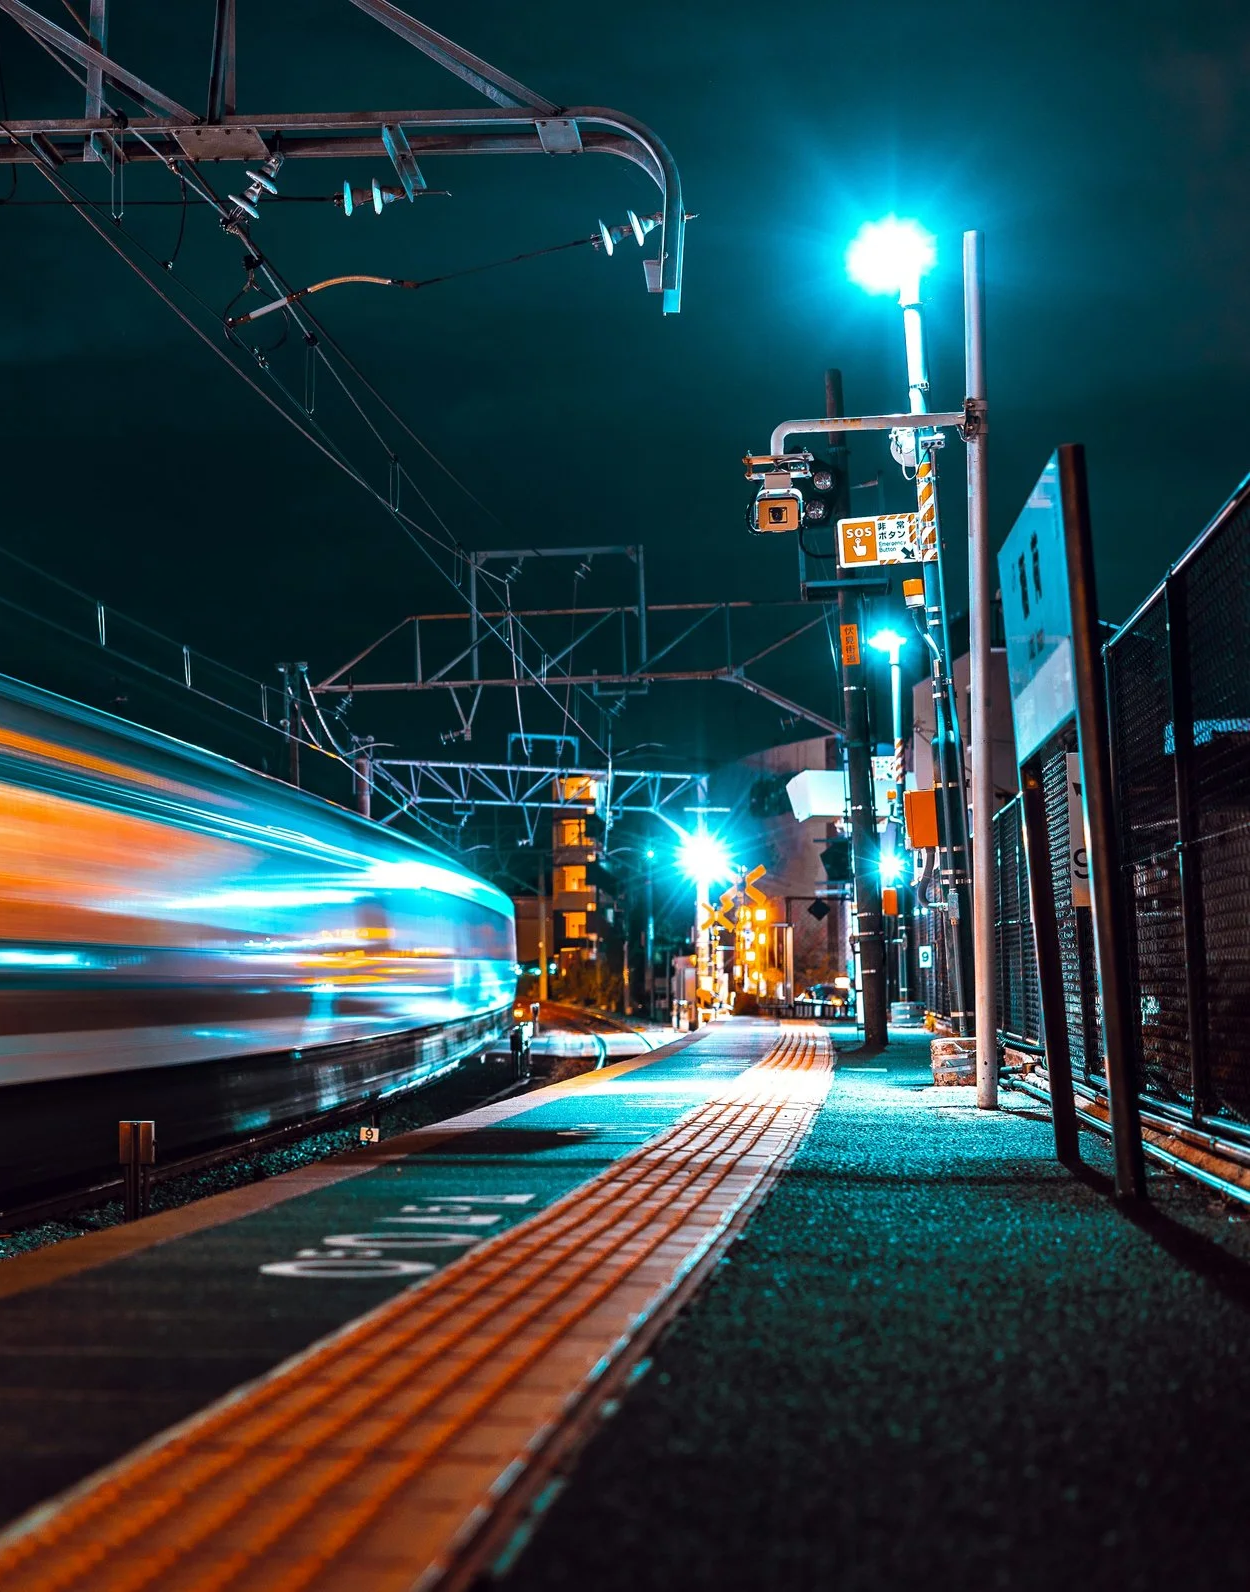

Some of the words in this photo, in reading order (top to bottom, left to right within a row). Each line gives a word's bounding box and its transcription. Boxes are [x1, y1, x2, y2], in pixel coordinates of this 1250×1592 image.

[846, 527, 872, 539] SOS
[878, 531, 906, 540] ボタン
[921, 951, 929, 962] 9
[365, 1129, 374, 1140] 9
